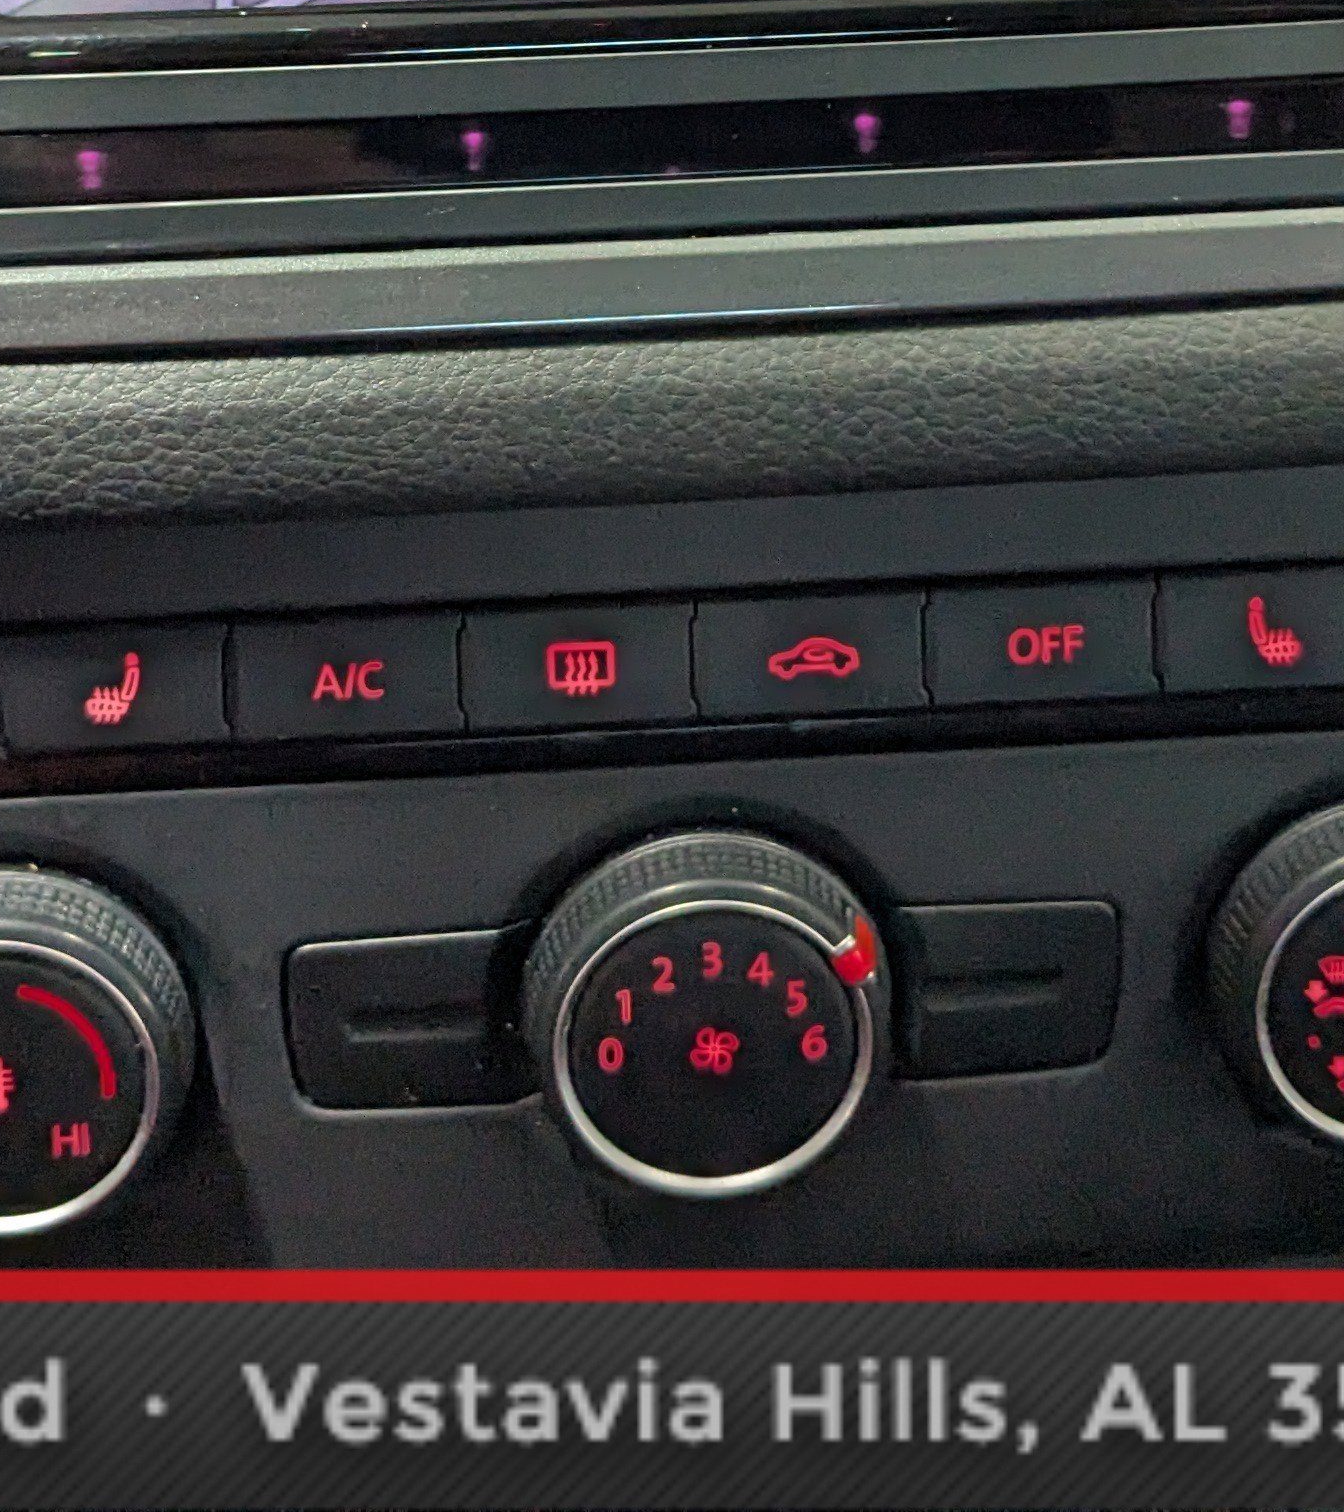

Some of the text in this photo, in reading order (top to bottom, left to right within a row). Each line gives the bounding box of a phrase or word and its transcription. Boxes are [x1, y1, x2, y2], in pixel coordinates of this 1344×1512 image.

[1008, 624, 1086, 666] OFF
[312, 660, 385, 701] A/C
[598, 941, 828, 1073] 0 1 2 3 4 5 6
[51, 1123, 91, 1158] HI
